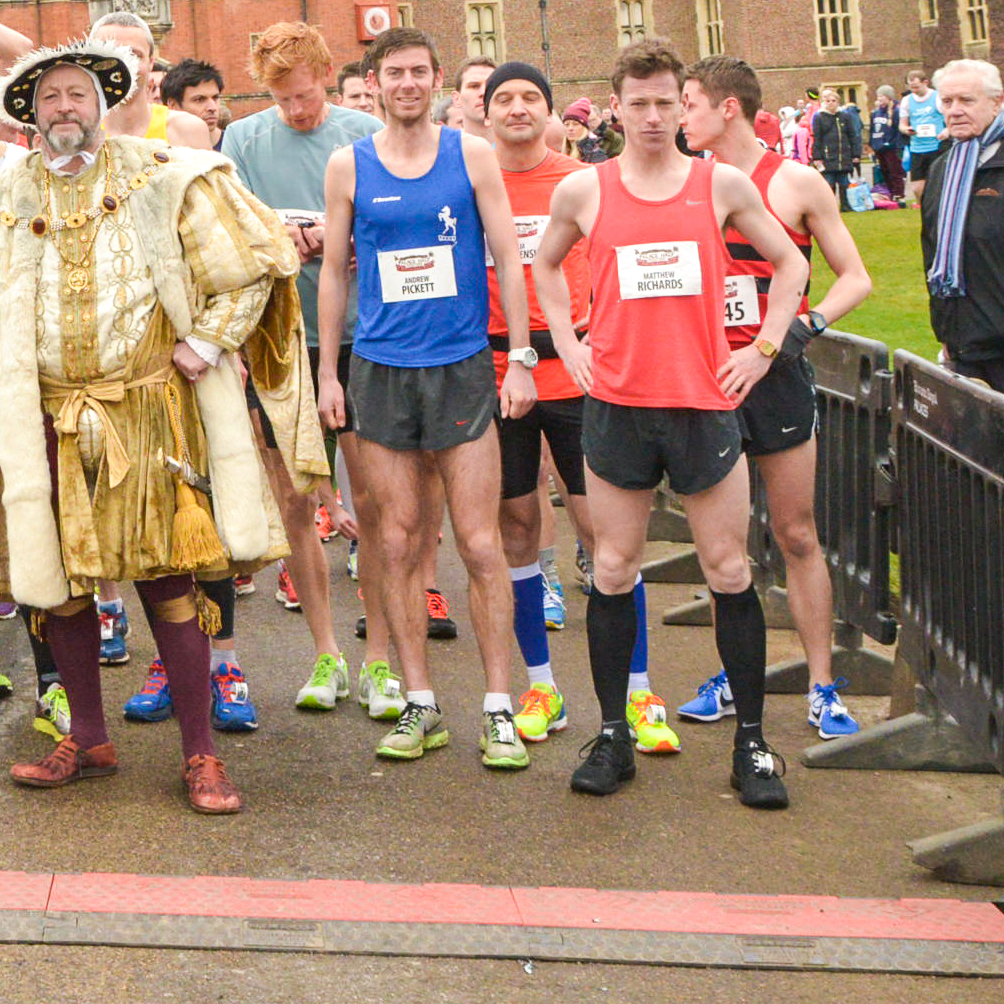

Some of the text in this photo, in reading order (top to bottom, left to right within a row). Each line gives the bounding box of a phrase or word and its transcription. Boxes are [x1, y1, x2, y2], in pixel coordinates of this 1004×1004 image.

[404, 276, 430, 284] ANDREW
[643, 271, 675, 280] MATTHEW
[402, 282, 435, 295] PICKETT
[637, 279, 683, 292] RICHARDS
